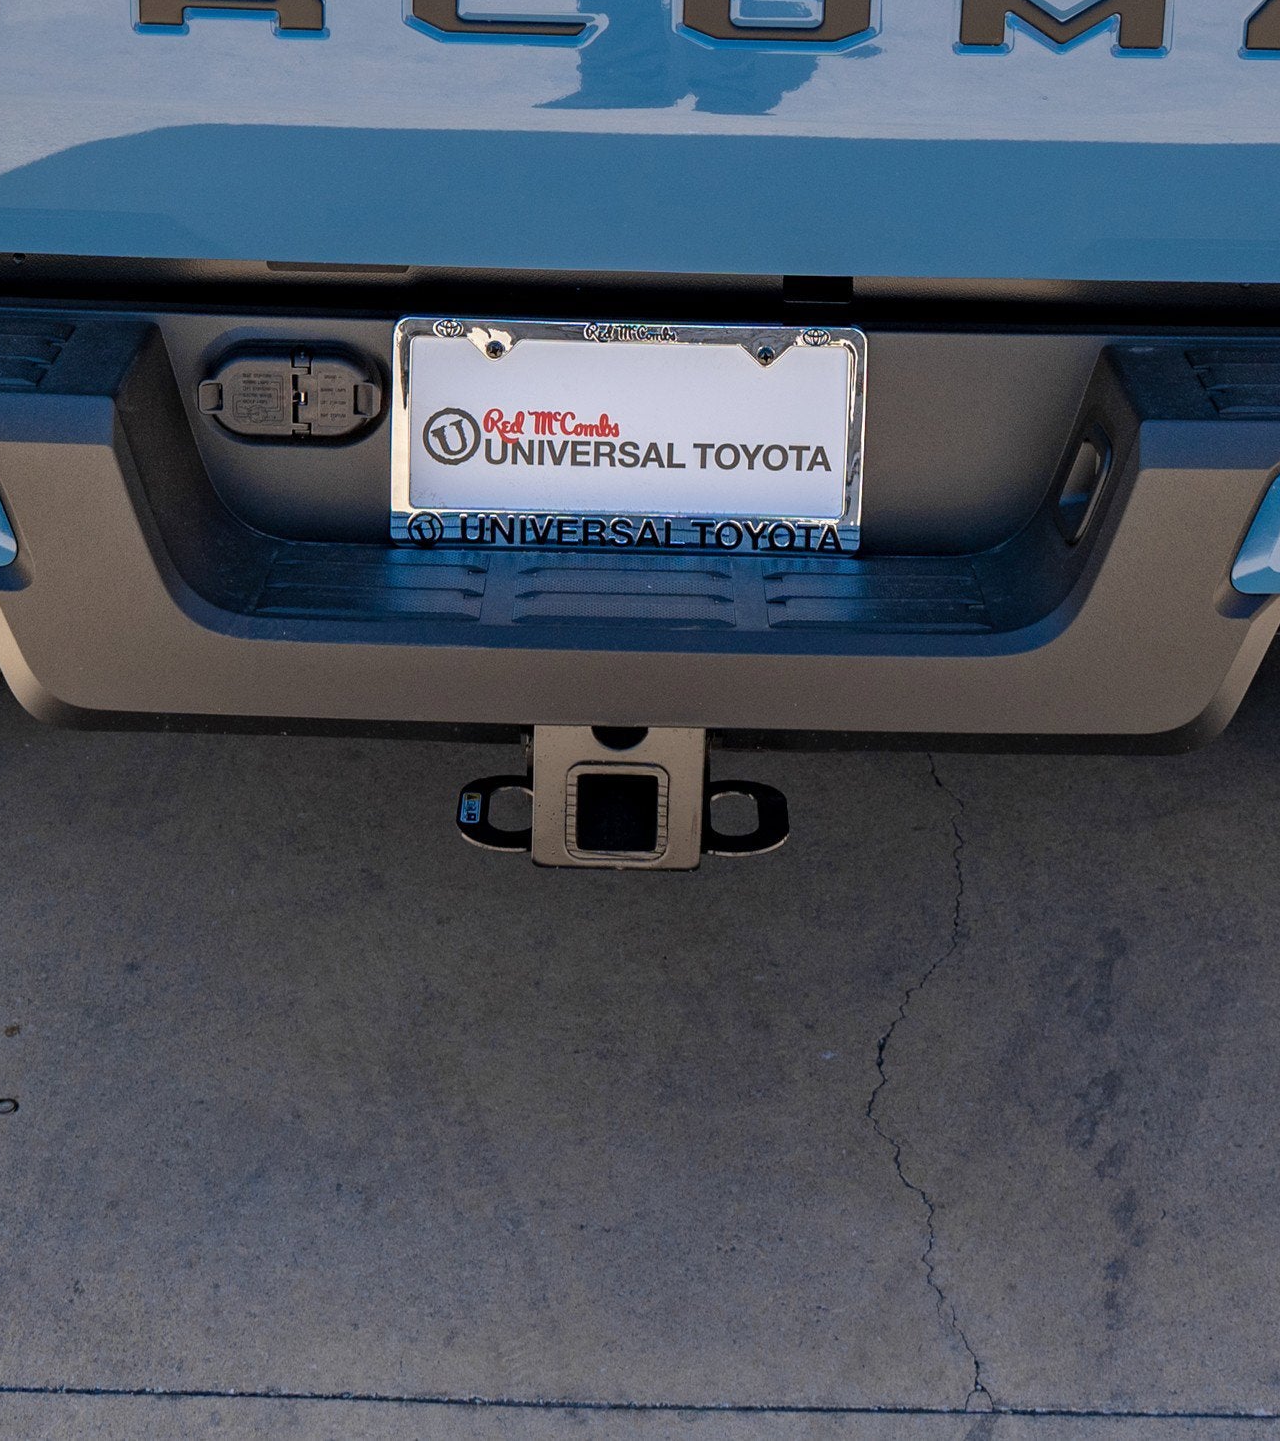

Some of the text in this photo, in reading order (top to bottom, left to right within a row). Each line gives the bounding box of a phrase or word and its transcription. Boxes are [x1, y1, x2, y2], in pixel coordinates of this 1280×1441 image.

[584, 321, 615, 343] Red
[483, 408, 620, 444] Red McCombs
[485, 438, 832, 473] UNIVERSAL TOYOTA
[459, 512, 686, 549] UNIVERSAL
[691, 519, 844, 551] TOYOTA
